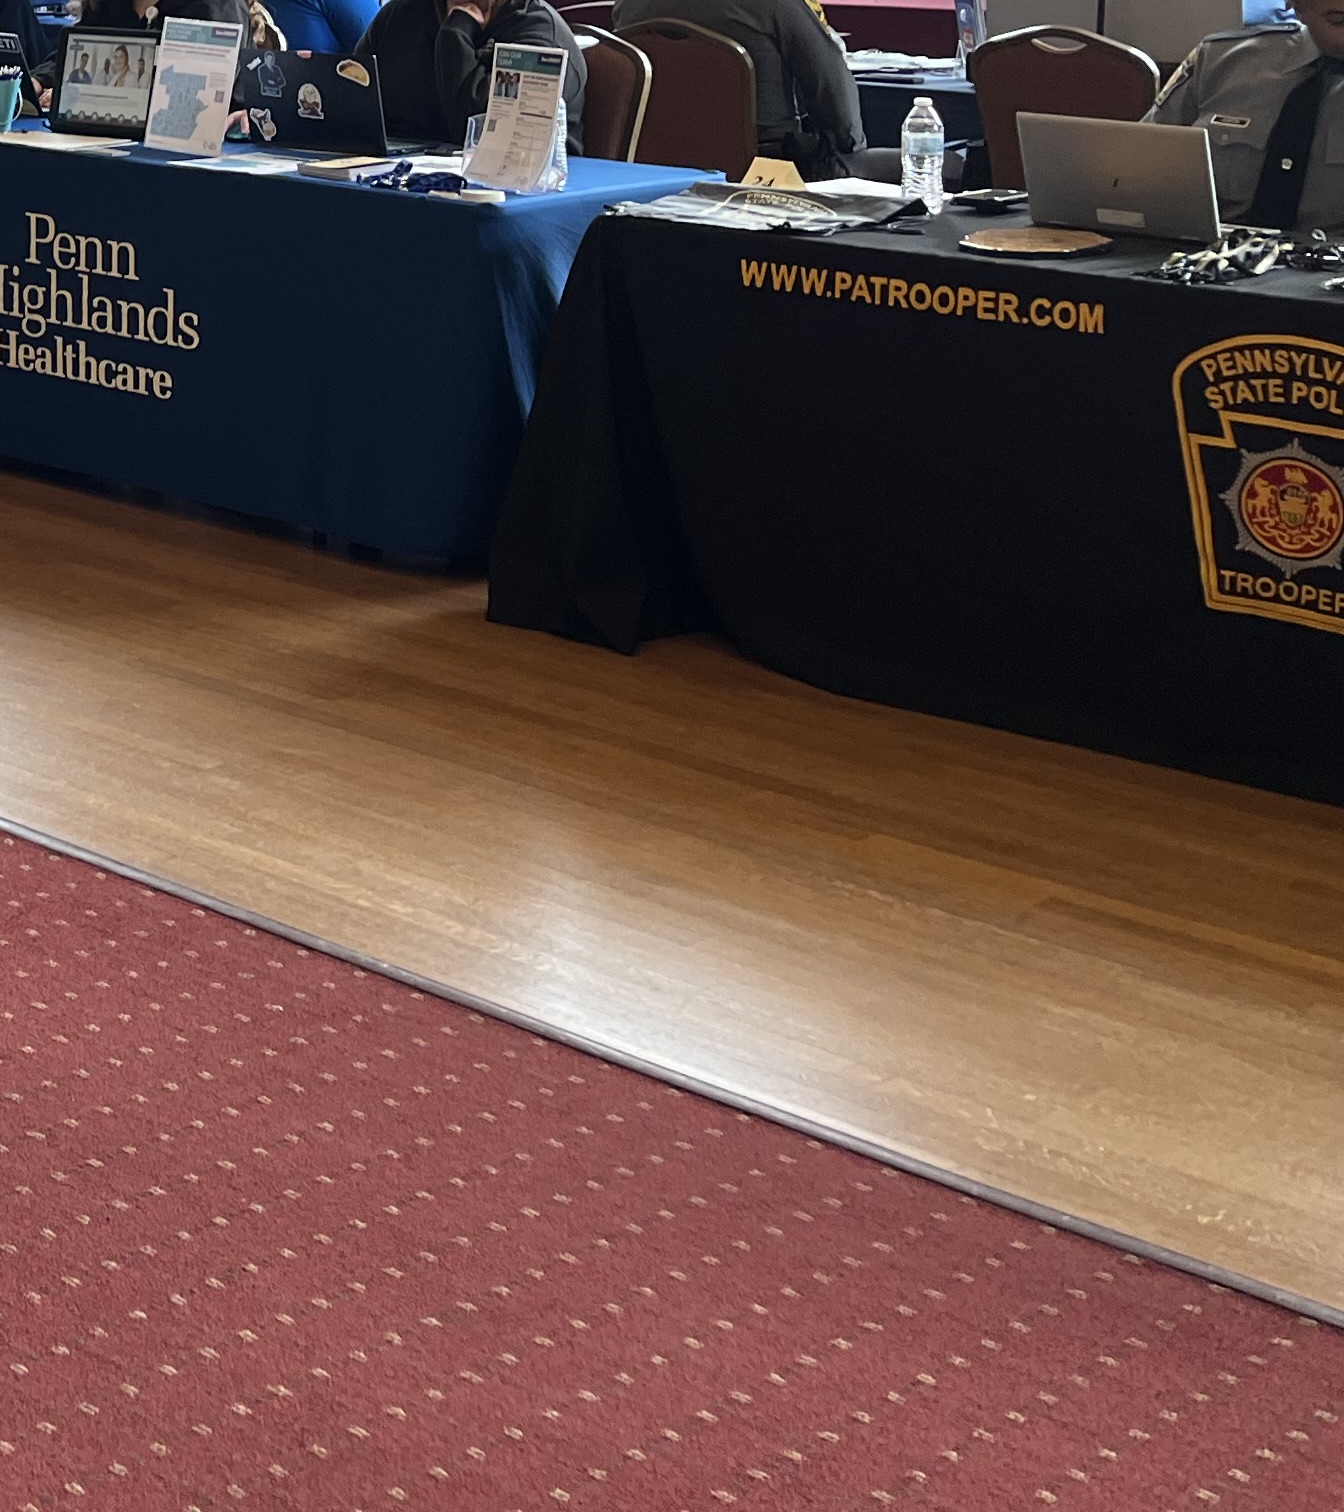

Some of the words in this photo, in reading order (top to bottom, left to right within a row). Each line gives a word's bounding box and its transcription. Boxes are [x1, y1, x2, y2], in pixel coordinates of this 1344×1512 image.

[24, 210, 140, 282] Penn
[740, 258, 1105, 336] WWW.PATROOPER.COM
[1204, 378, 1286, 411] STATE
[1292, 380, 1344, 416] POL
